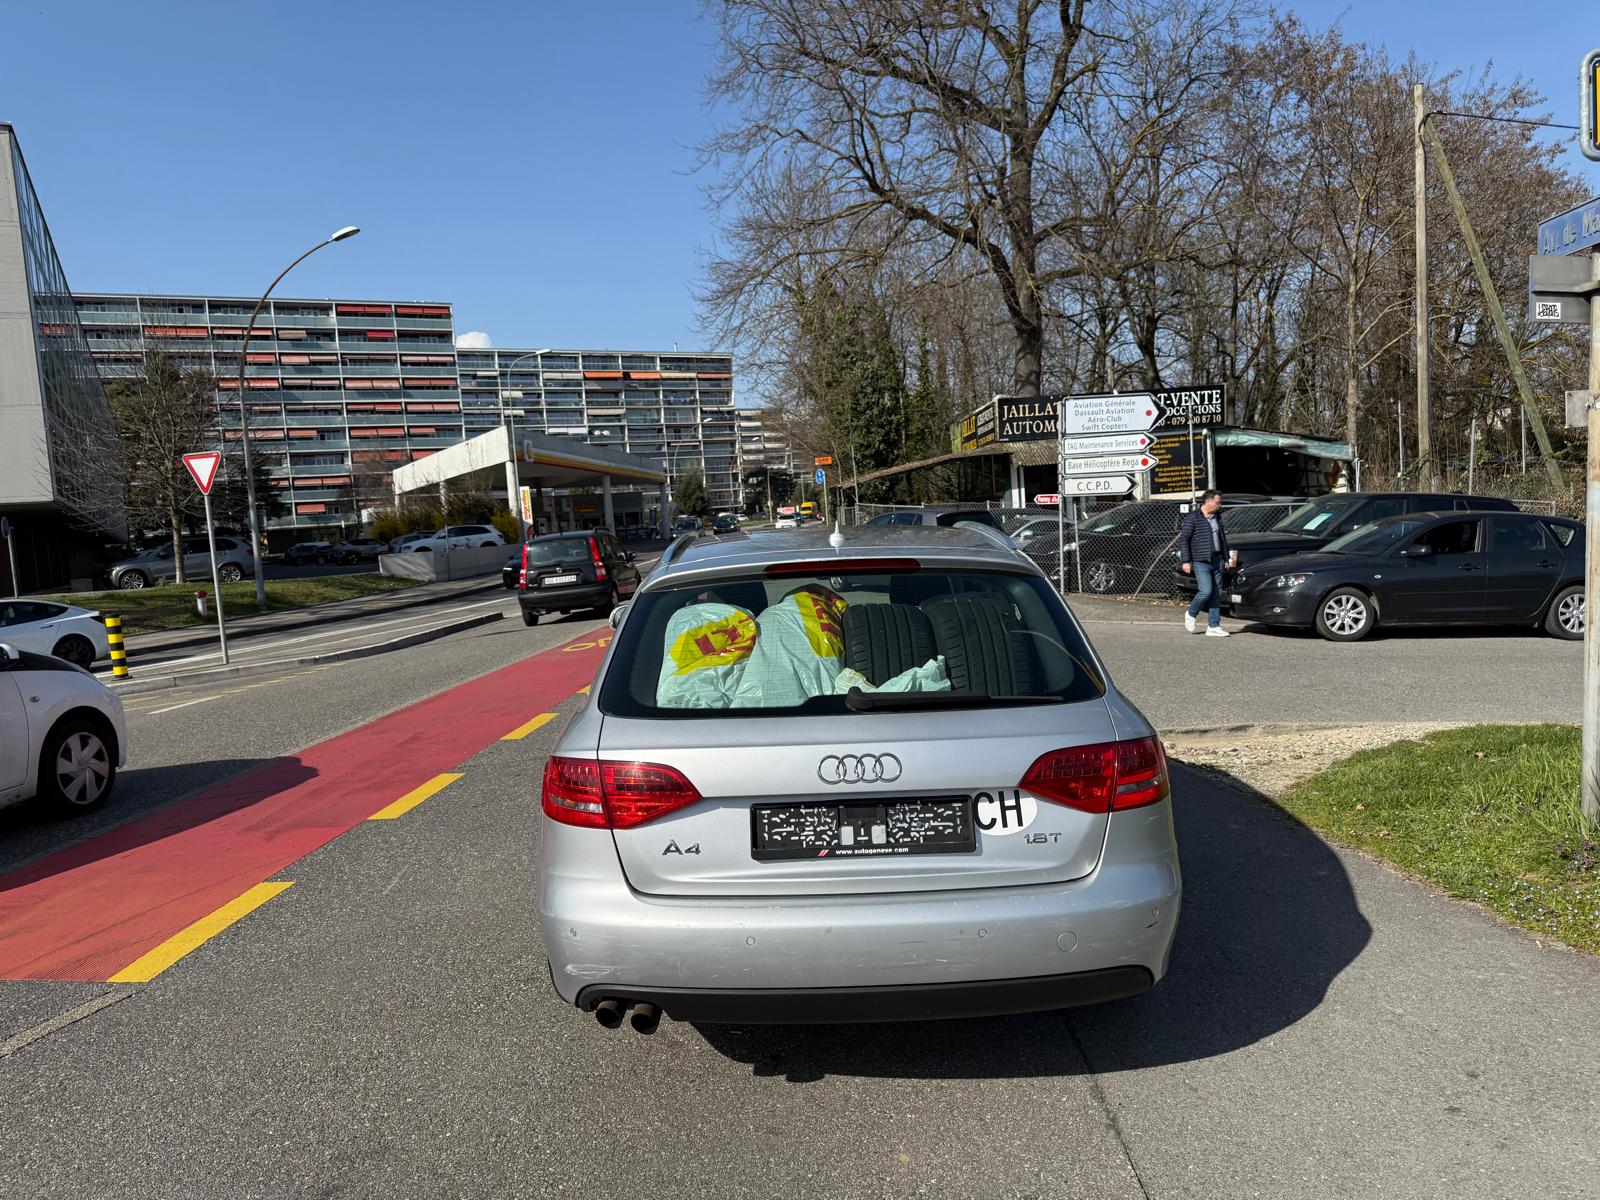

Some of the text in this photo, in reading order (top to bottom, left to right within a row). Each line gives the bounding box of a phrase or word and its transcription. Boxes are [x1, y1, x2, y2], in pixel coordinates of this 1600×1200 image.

[1563, 222, 1577, 246] de
[1105, 399, 1136, 407] Générale
[1172, 417, 1185, 425] 079
[1202, 415, 1210, 423] 87
[1213, 414, 1221, 423] 10
[1101, 423, 1128, 431] Copters
[1067, 439, 1138, 450] TAG Maintenance Services
[1068, 458, 1139, 469] Base Hélicoptère Rega
[1077, 480, 1113, 492] C.C.P.D.
[974, 789, 1023, 831] CH
[662, 839, 701, 855] A4
